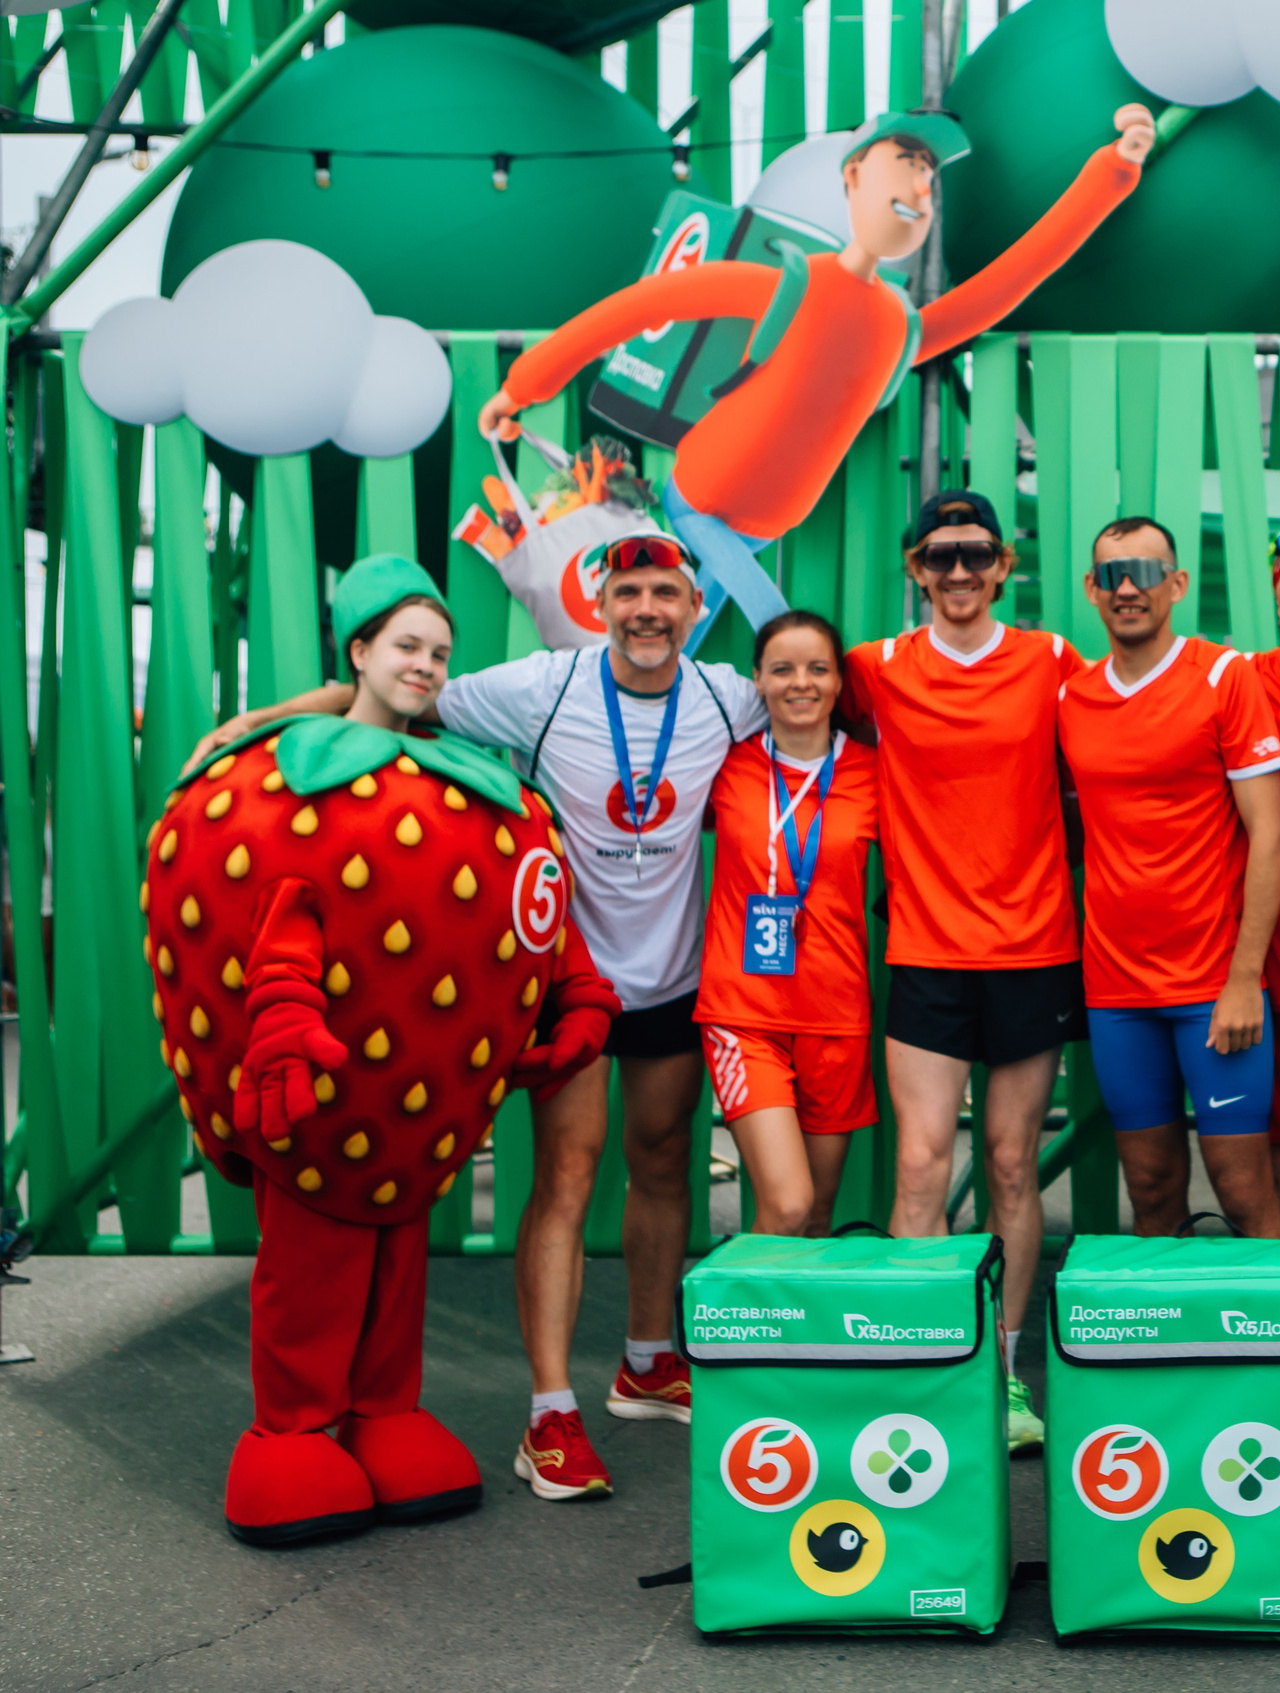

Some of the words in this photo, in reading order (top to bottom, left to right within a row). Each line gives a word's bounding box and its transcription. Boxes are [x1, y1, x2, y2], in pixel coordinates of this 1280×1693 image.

[596, 845, 677, 859] выруаем!
[528, 858, 559, 934] 5
[754, 917, 778, 957] 3
[778, 918, 788, 957] МЕСТО
[693, 1304, 806, 1321] Доставляем
[1069, 1305, 1182, 1322] Доставляем
[694, 1326, 782, 1341] продукты
[1070, 1326, 1158, 1342] продукты
[746, 1425, 797, 1494] 5
[1096, 1431, 1146, 1502] 5
[915, 1595, 961, 1609] 25649
